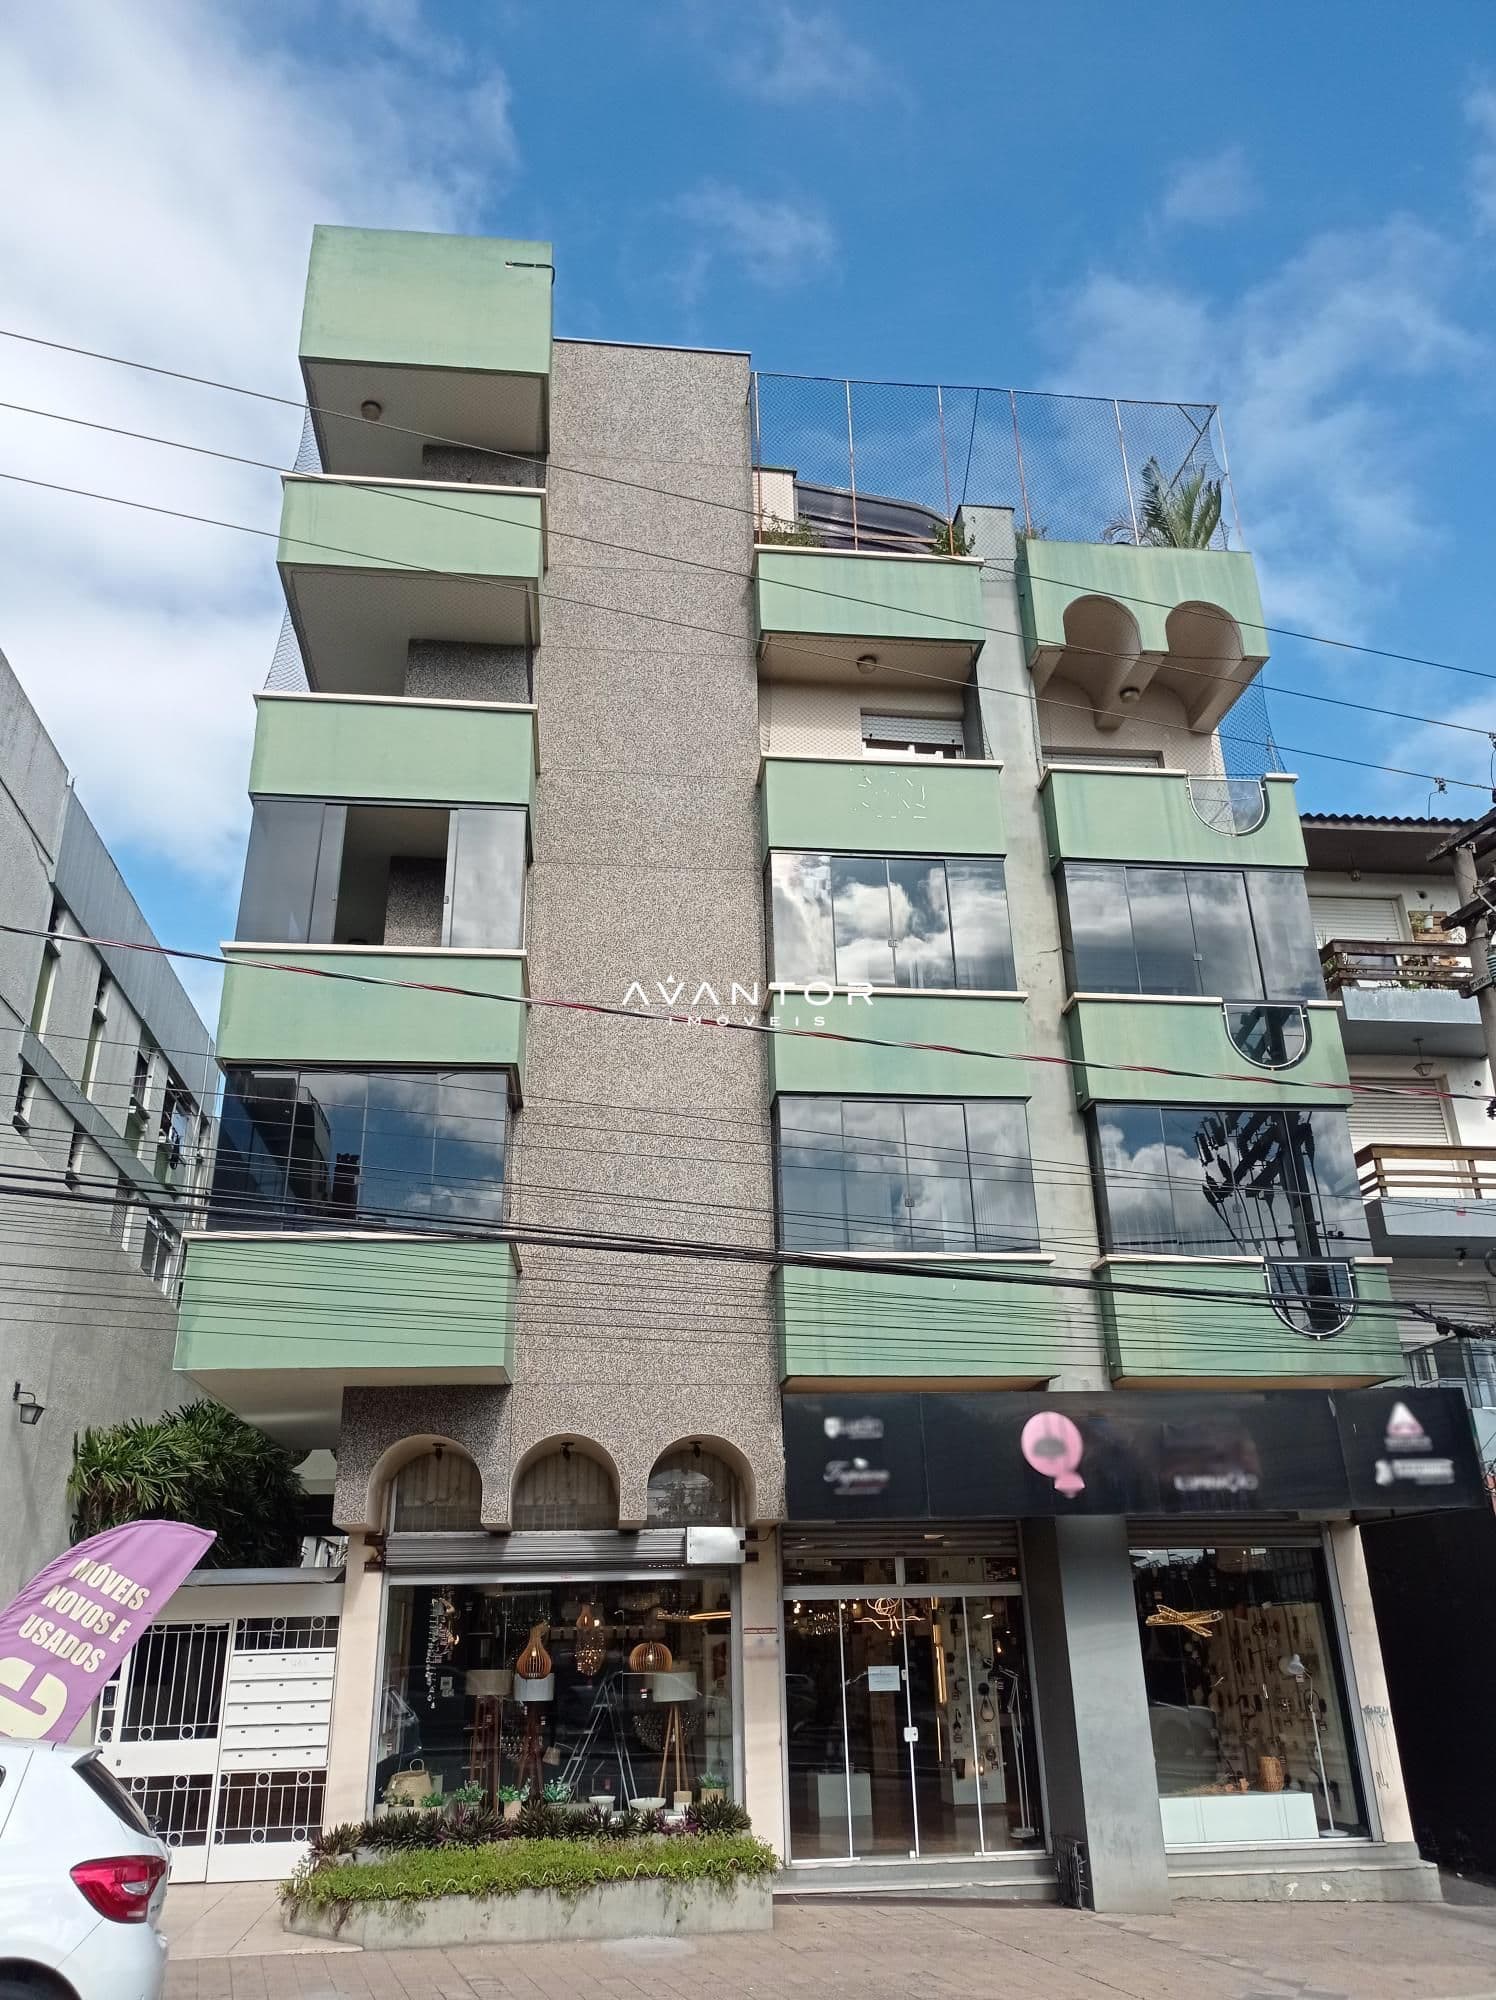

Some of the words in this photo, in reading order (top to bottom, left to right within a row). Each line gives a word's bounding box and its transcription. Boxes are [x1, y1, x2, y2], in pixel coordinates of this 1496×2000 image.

[41, 1585, 116, 1635] NOVOS
[109, 1619, 132, 1643] E
[69, 1559, 150, 1611] MÓVEIS
[18, 1614, 106, 1673] USADOS
